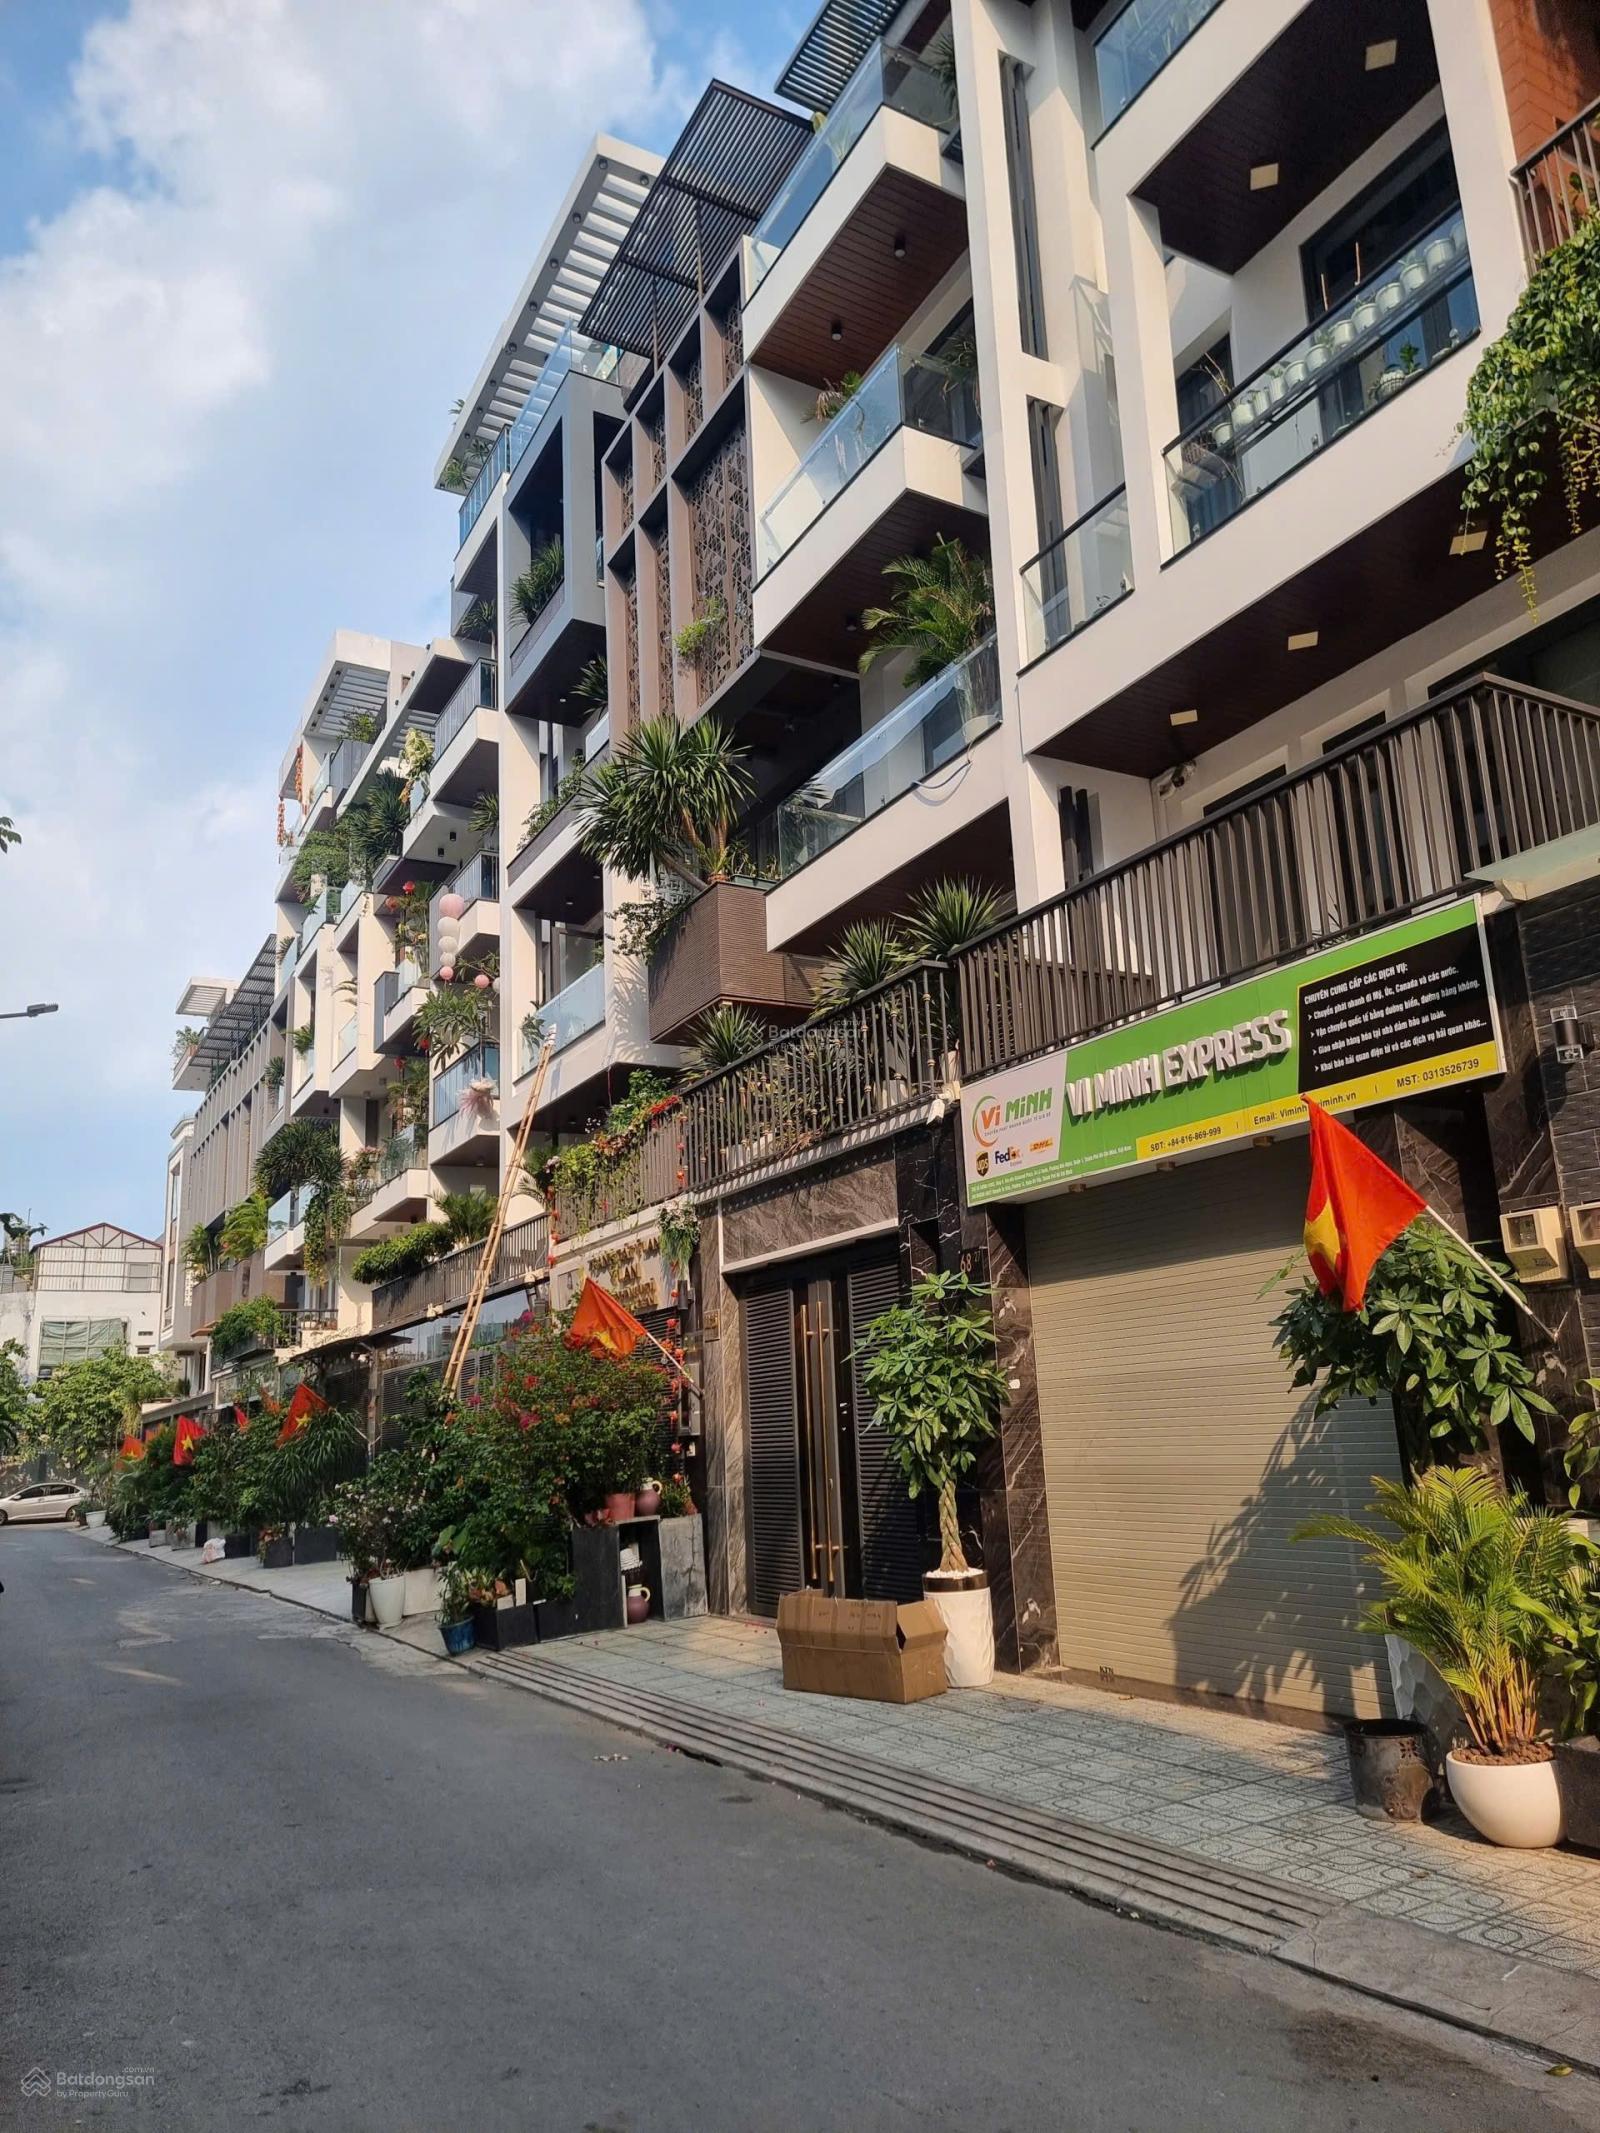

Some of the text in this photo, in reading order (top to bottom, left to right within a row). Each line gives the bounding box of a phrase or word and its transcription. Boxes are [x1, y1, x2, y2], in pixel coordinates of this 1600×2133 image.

[1330, 982, 1348, 996] CUNG
[1348, 976, 1362, 989] CẤP
[1363, 972, 1378, 984] CÁC
[1347, 996, 1365, 1009] nhanh
[1395, 979, 1418, 993] Canada
[1428, 971, 1440, 982] các
[1421, 1015, 1430, 1024] an
[1066, 1009, 1293, 1117] VI MINH EXPRESS
[1396, 1058, 1480, 1088] MST: 0313526739
[981, 1104, 1001, 1130] Vi
[1254, 1112, 1278, 1125] Email:
